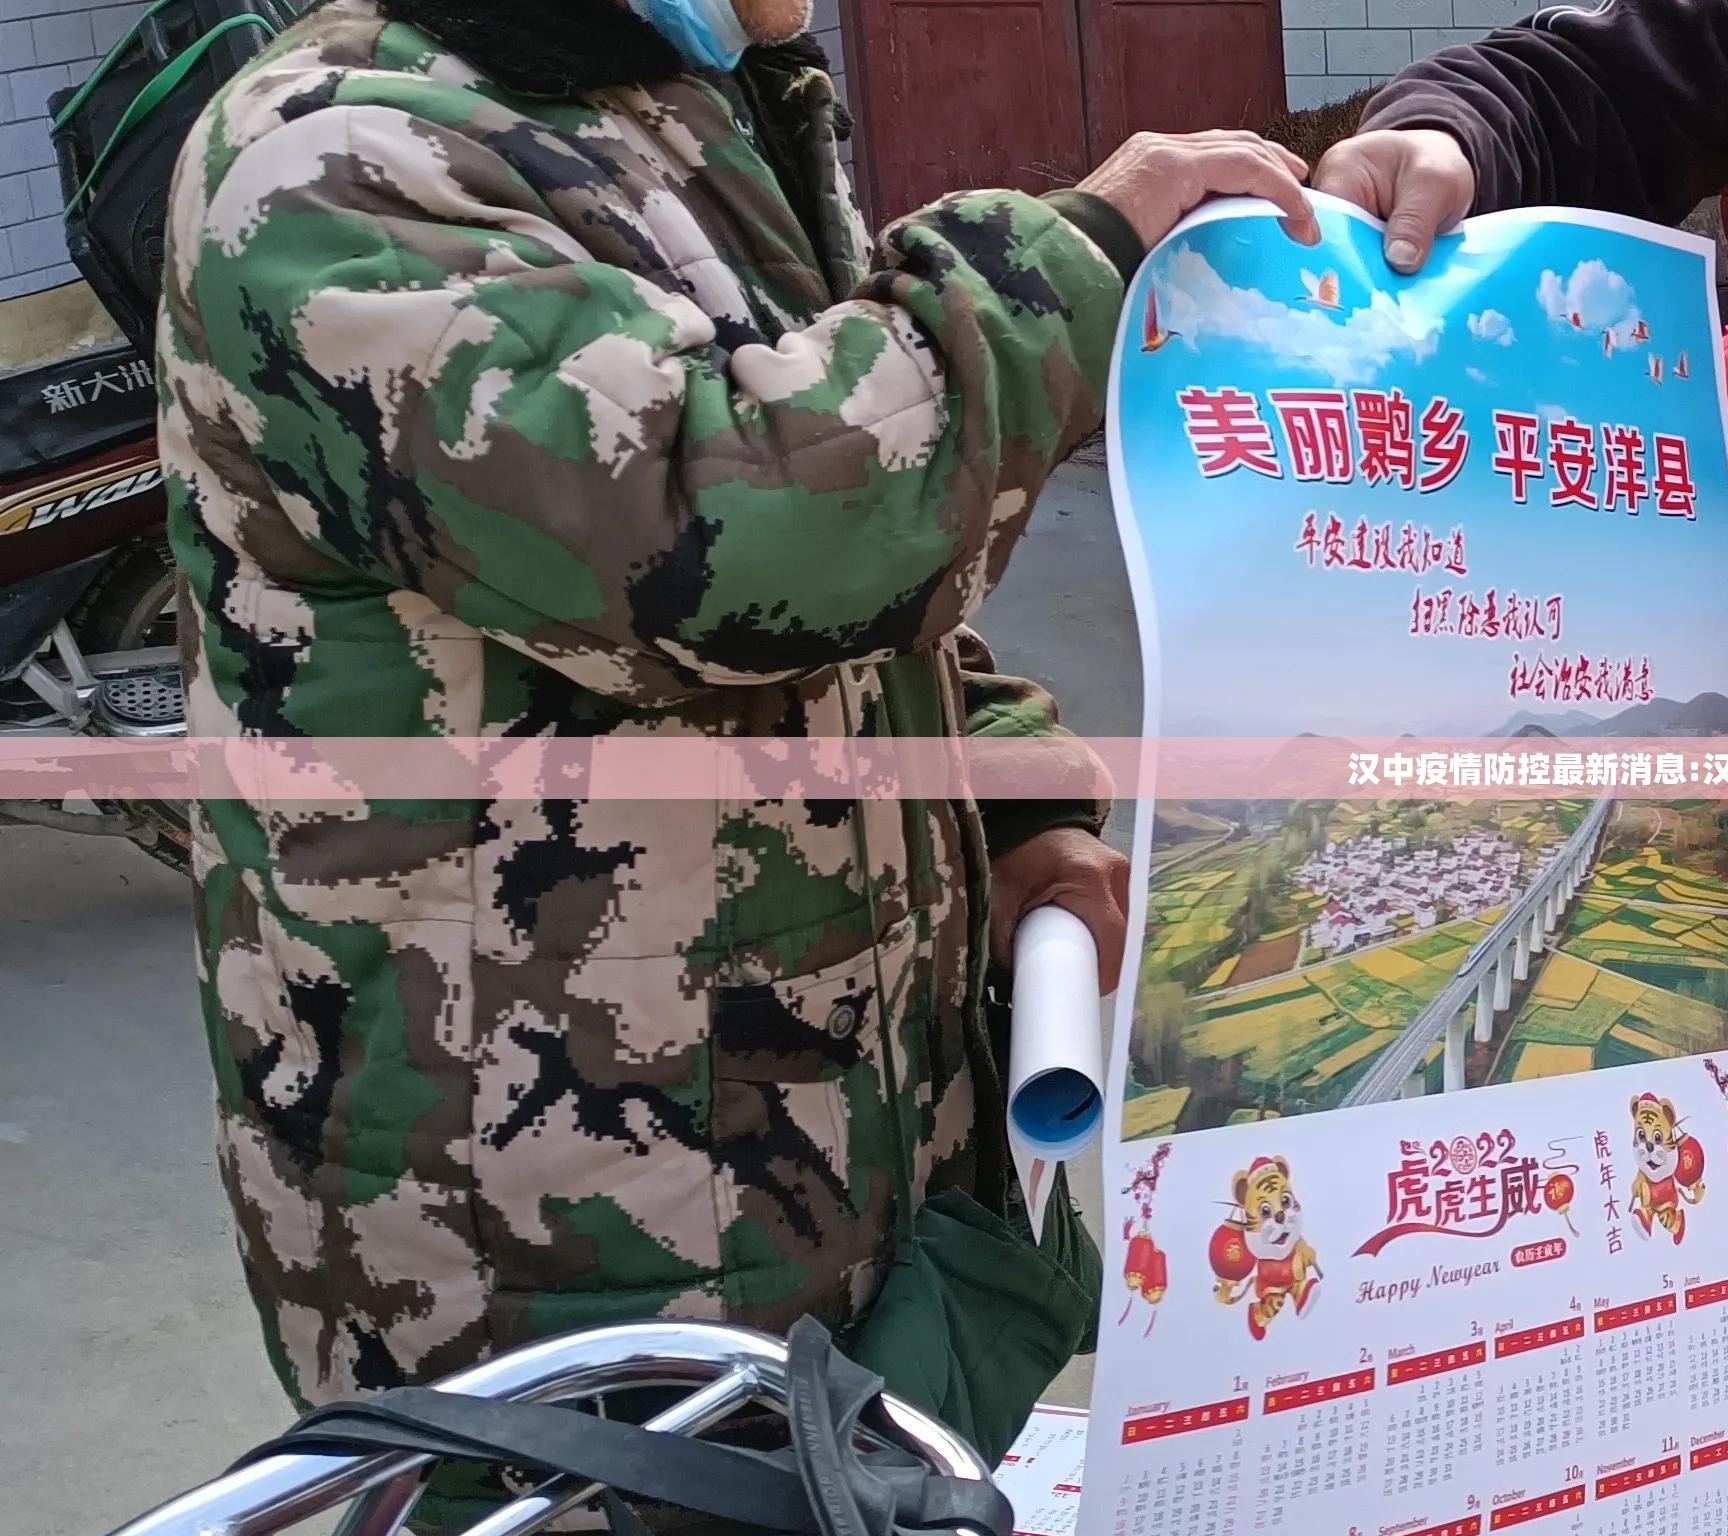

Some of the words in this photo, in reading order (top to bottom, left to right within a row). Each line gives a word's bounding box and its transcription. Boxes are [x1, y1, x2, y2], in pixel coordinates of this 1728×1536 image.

[1491, 410, 1697, 519] 平安洋县
[1295, 513, 1468, 576] 平安建设我知道
[1410, 588, 1563, 639] 扫黑除恶我认可
[1509, 653, 1656, 704] 社会治安我满意
[1387, 1154, 1542, 1226] 虎虎生威
[1594, 1130, 1624, 1255] 虎年大吉
[1355, 1276, 1421, 1305] Happy
[1426, 1260, 1501, 1290] Newyear
